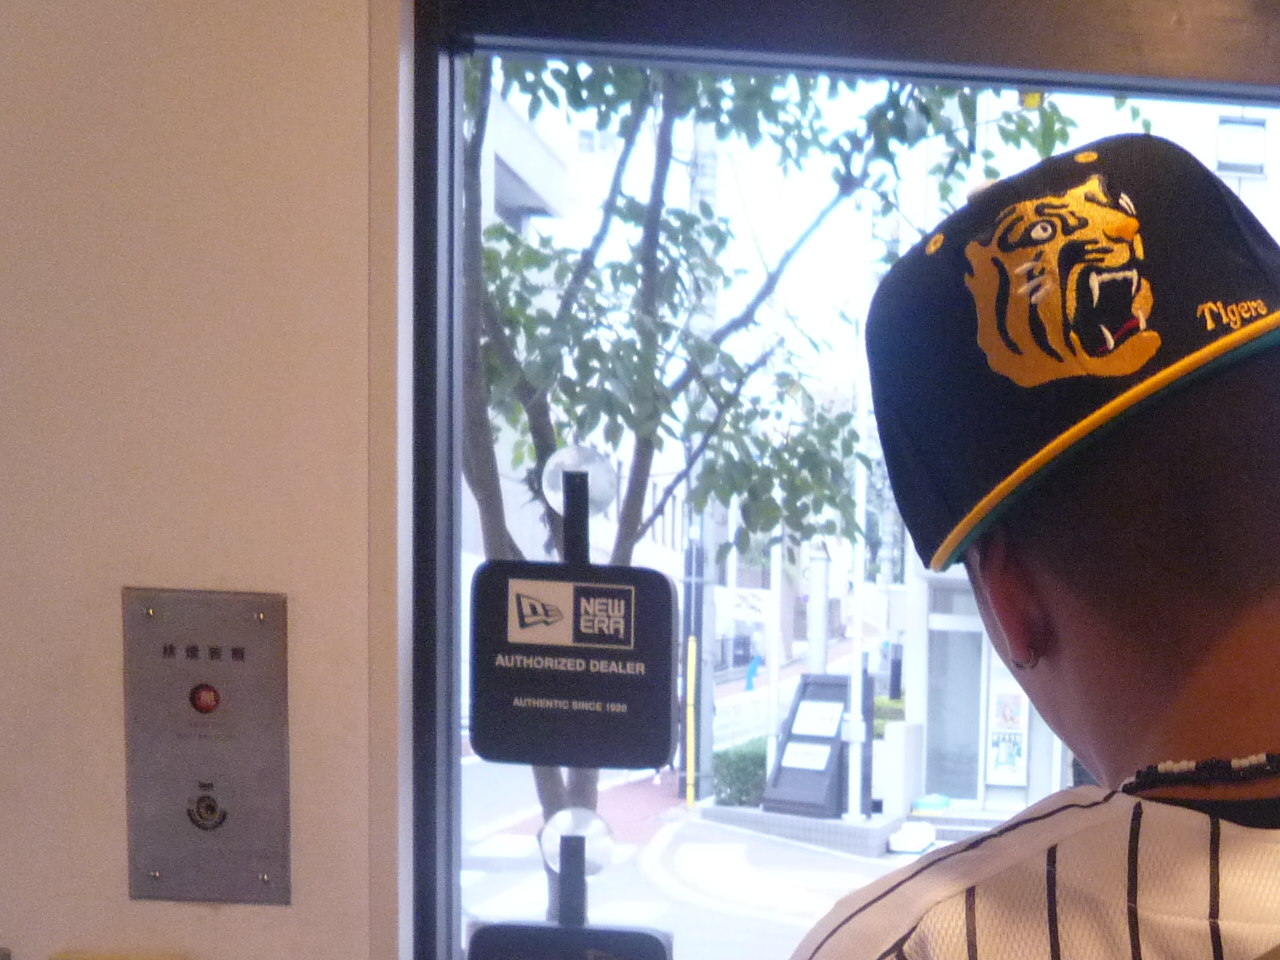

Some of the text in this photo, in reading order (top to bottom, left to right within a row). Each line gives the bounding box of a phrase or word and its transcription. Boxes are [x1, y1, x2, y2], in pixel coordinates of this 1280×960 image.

[1196, 299, 1268, 331] Tigers
[580, 597, 625, 617] NEW
[580, 616, 625, 639] ERA
[495, 654, 646, 676] AUTHORIZED DEALER
[512, 697, 570, 711] AUTHENTIC
[572, 700, 602, 712] SINCE
